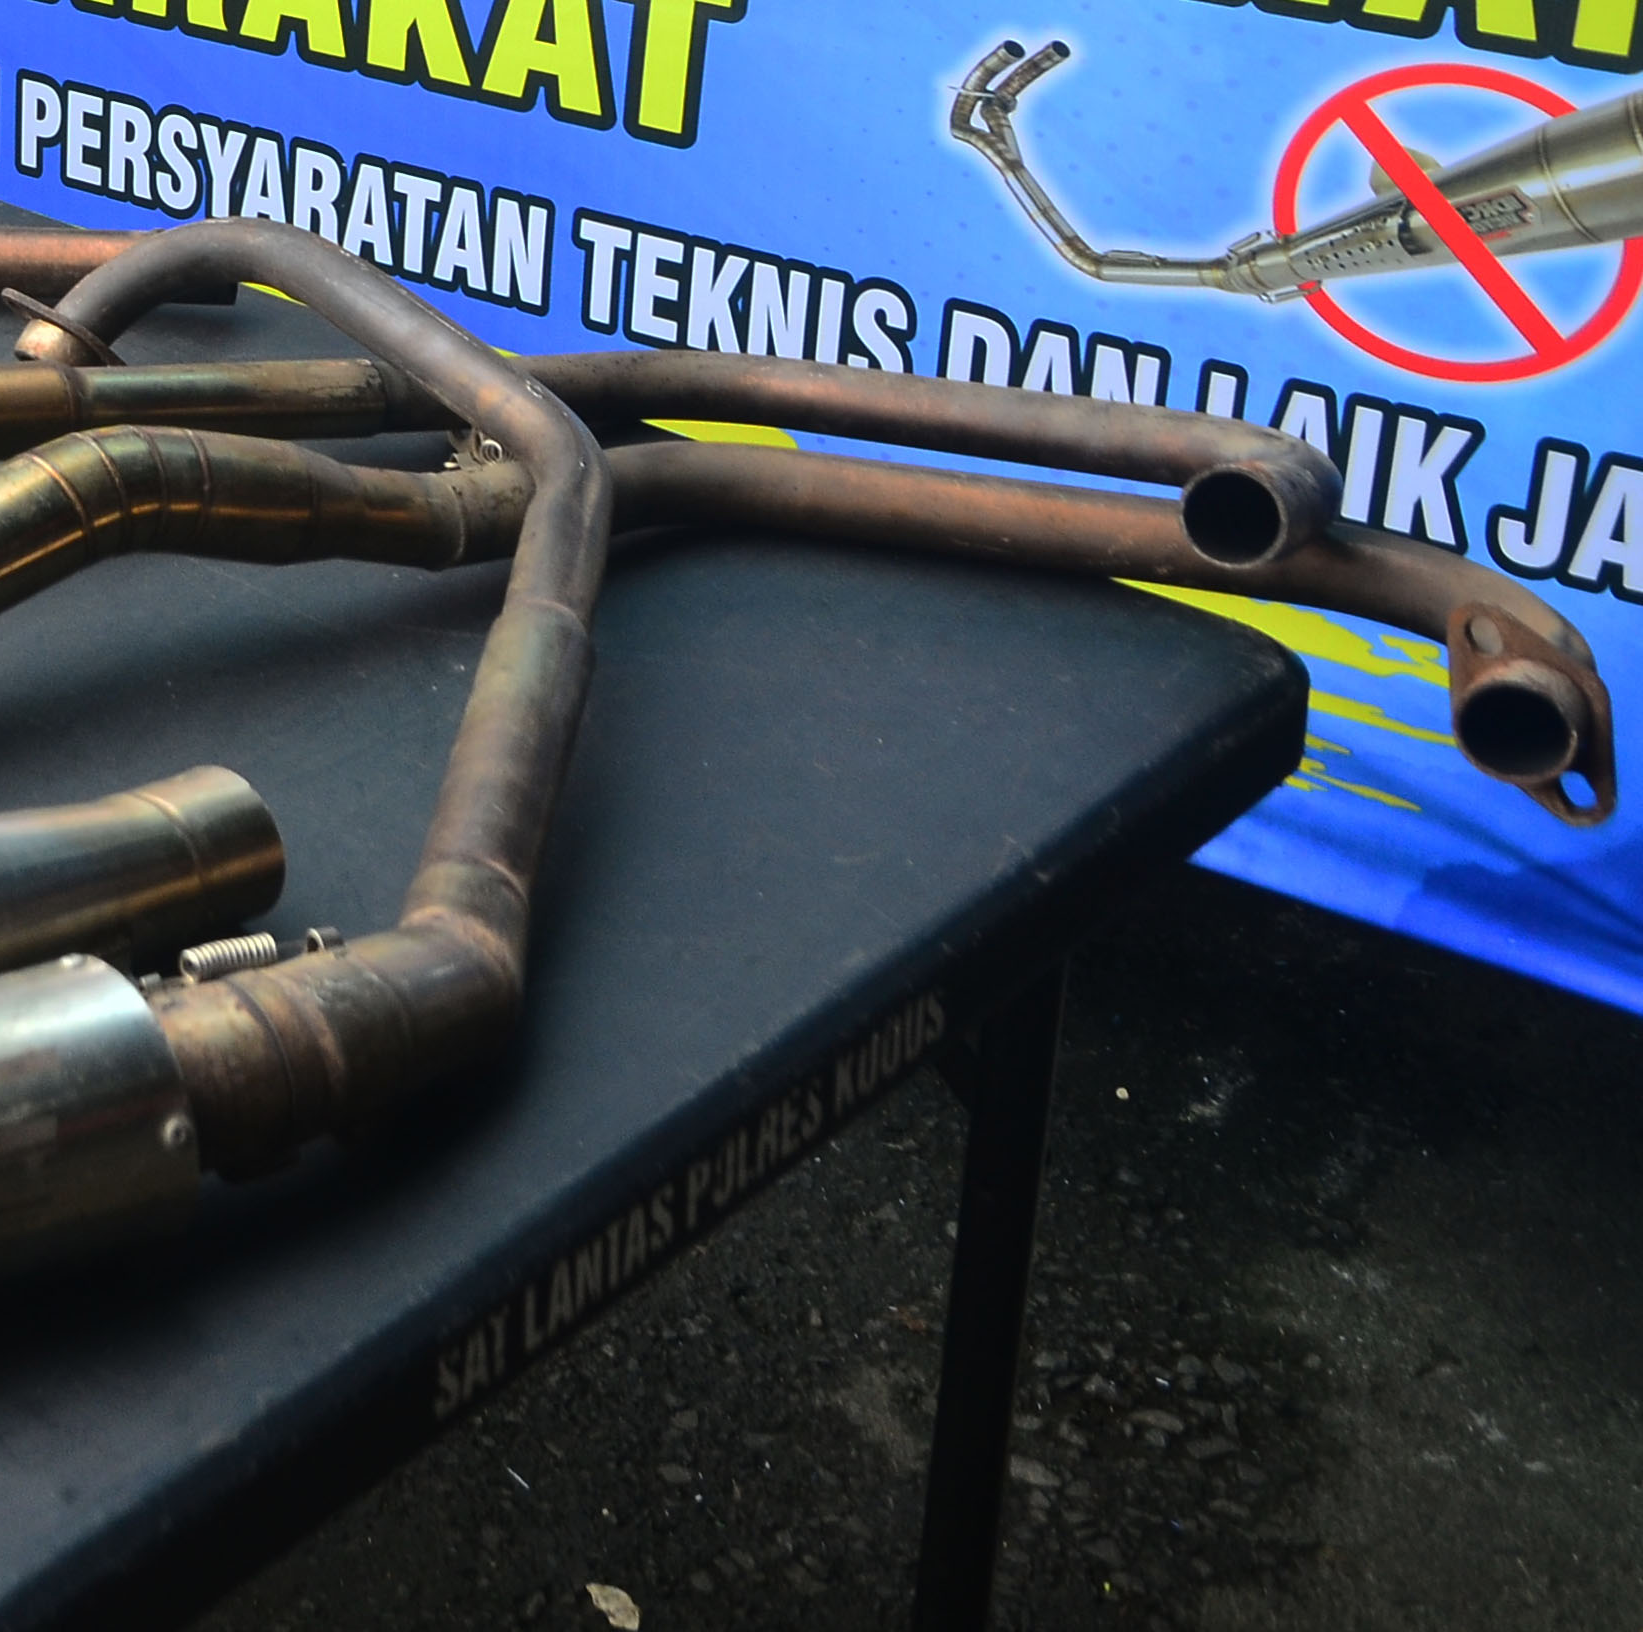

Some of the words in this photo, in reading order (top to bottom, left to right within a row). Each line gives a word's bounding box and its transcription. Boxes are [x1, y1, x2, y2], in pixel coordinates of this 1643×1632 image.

[19, 76, 549, 308] PERSYARATAN
[579, 217, 911, 374] TEKNIS
[945, 308, 1162, 408] DAN
[433, 1302, 515, 1422] SAT
[523, 1182, 676, 1354] LANTAS
